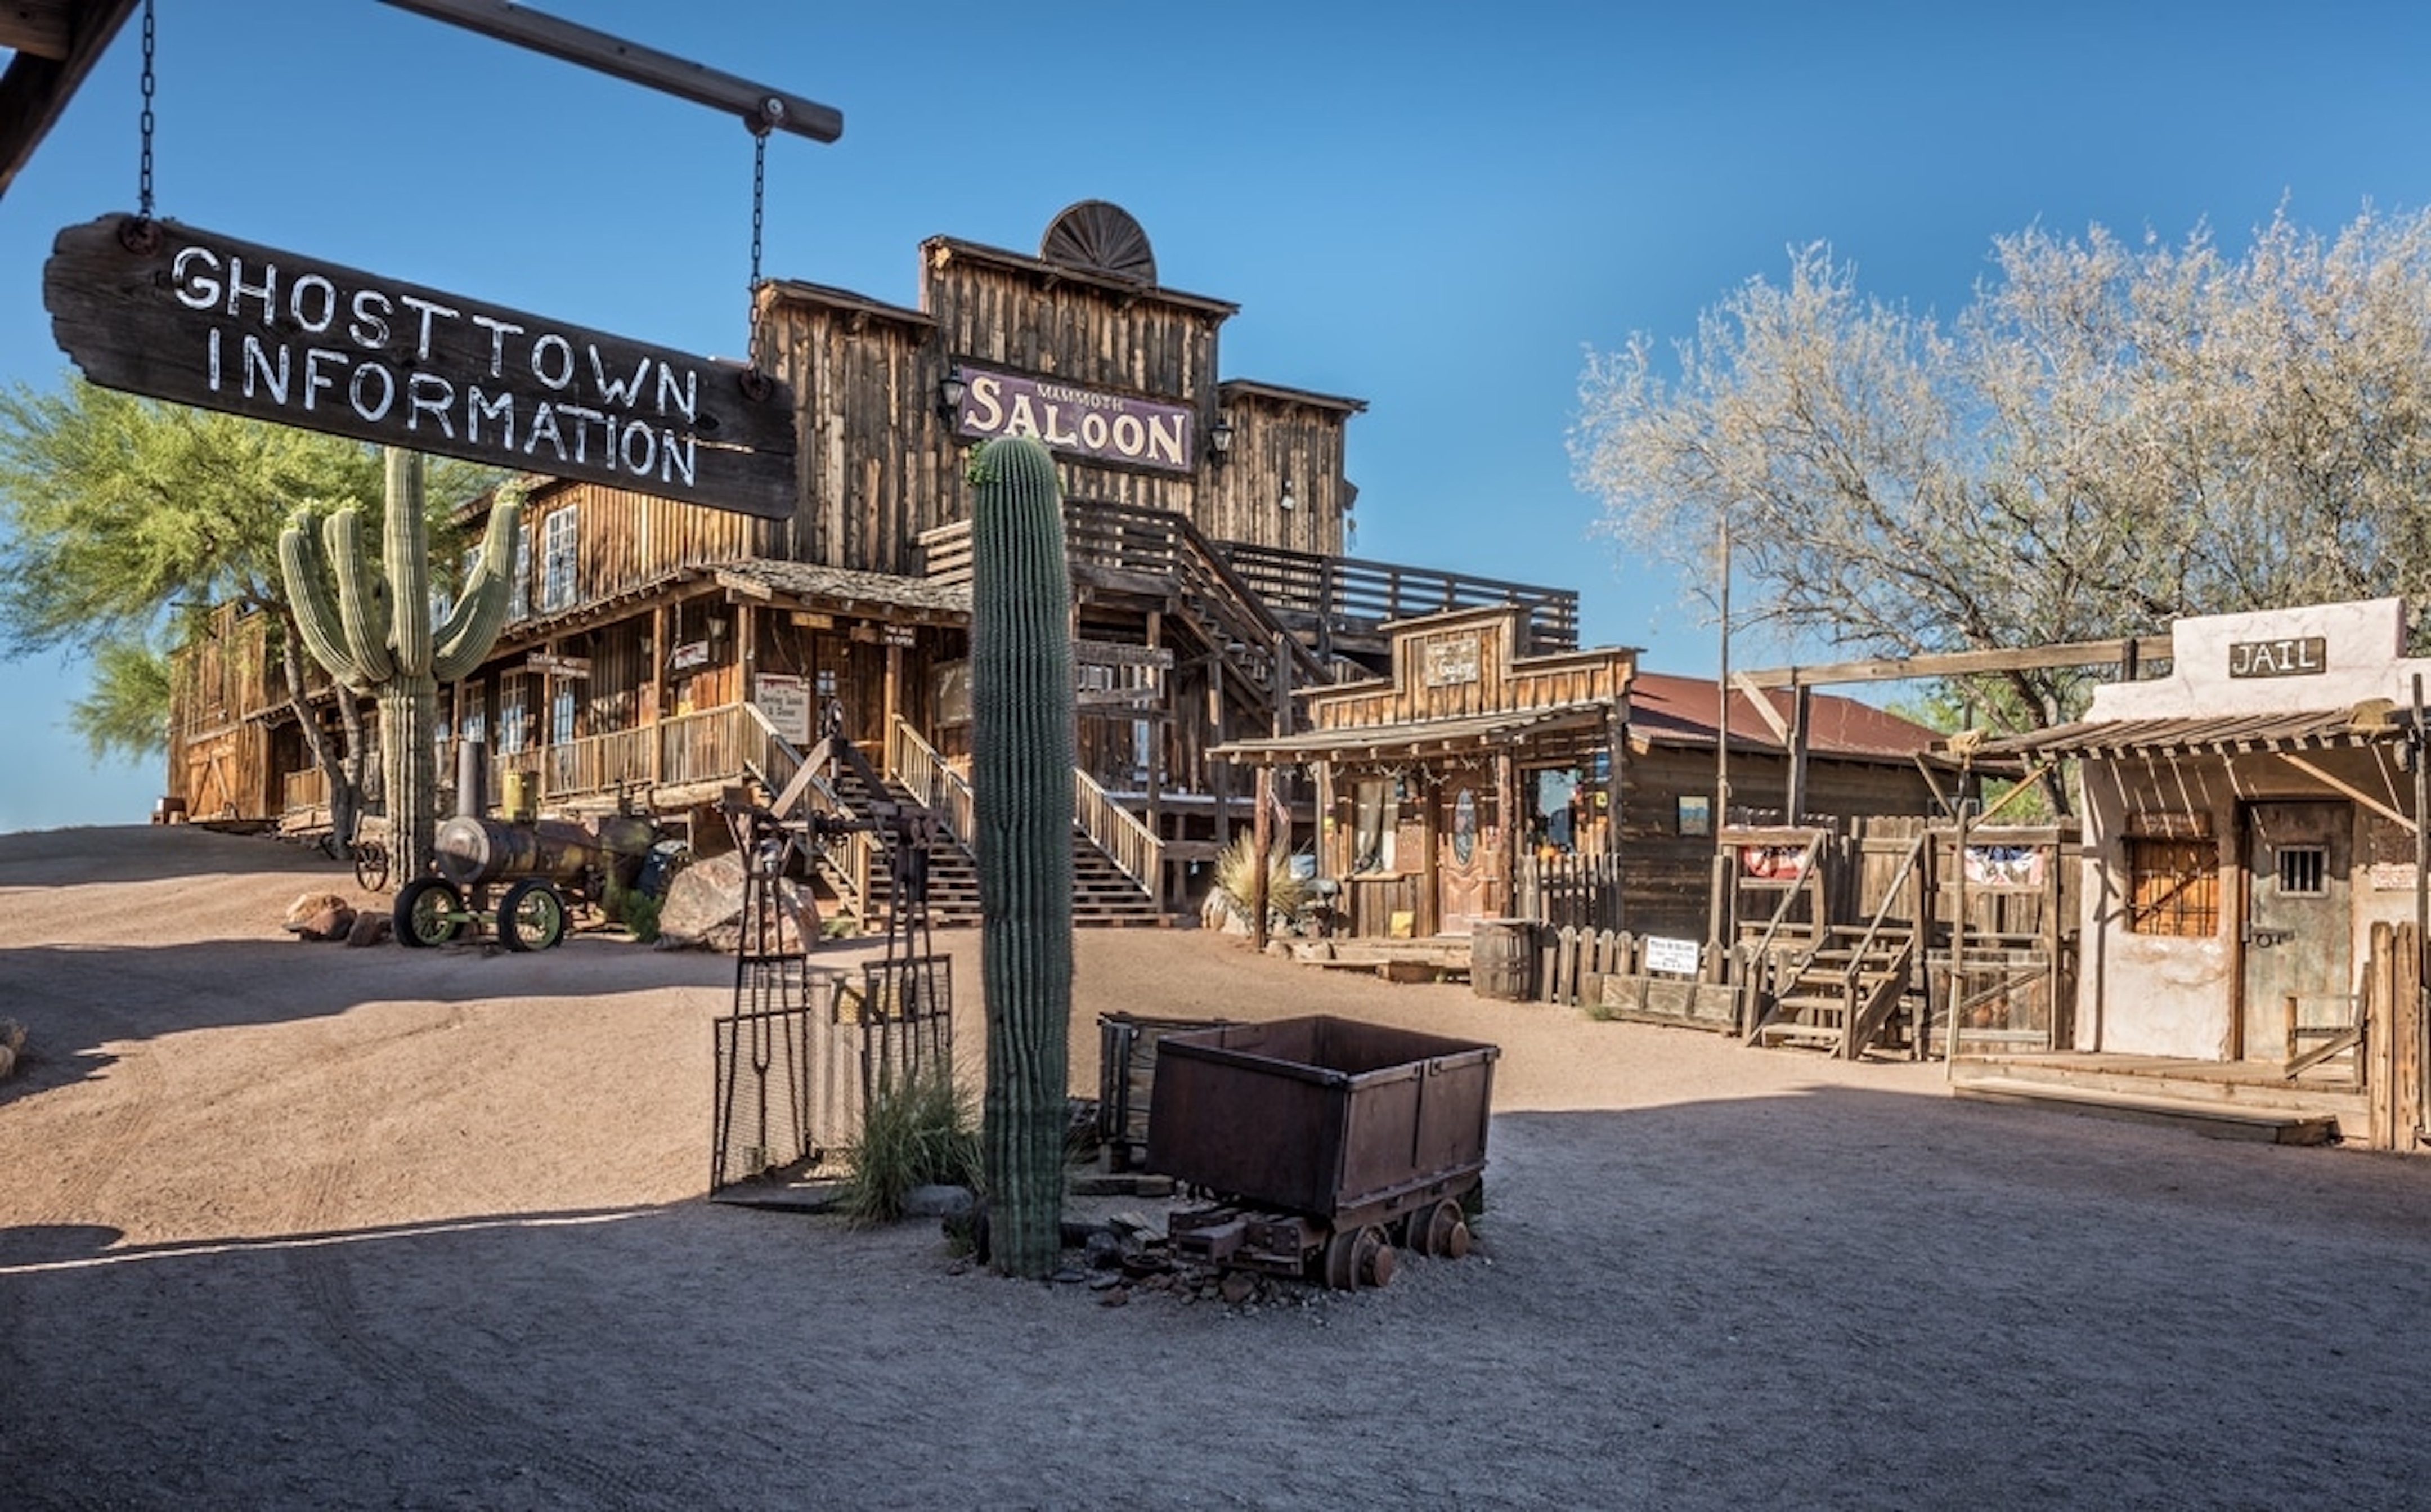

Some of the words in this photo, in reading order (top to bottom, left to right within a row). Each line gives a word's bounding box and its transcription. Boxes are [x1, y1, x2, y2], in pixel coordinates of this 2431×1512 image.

[172, 246, 461, 361] GHOST
[472, 314, 697, 424] TOWN
[208, 327, 696, 487] INFORMATION
[964, 375, 1185, 465] SALOON
[1037, 382, 1124, 412] MAMMOTH
[2232, 640, 2317, 674] JAIL
